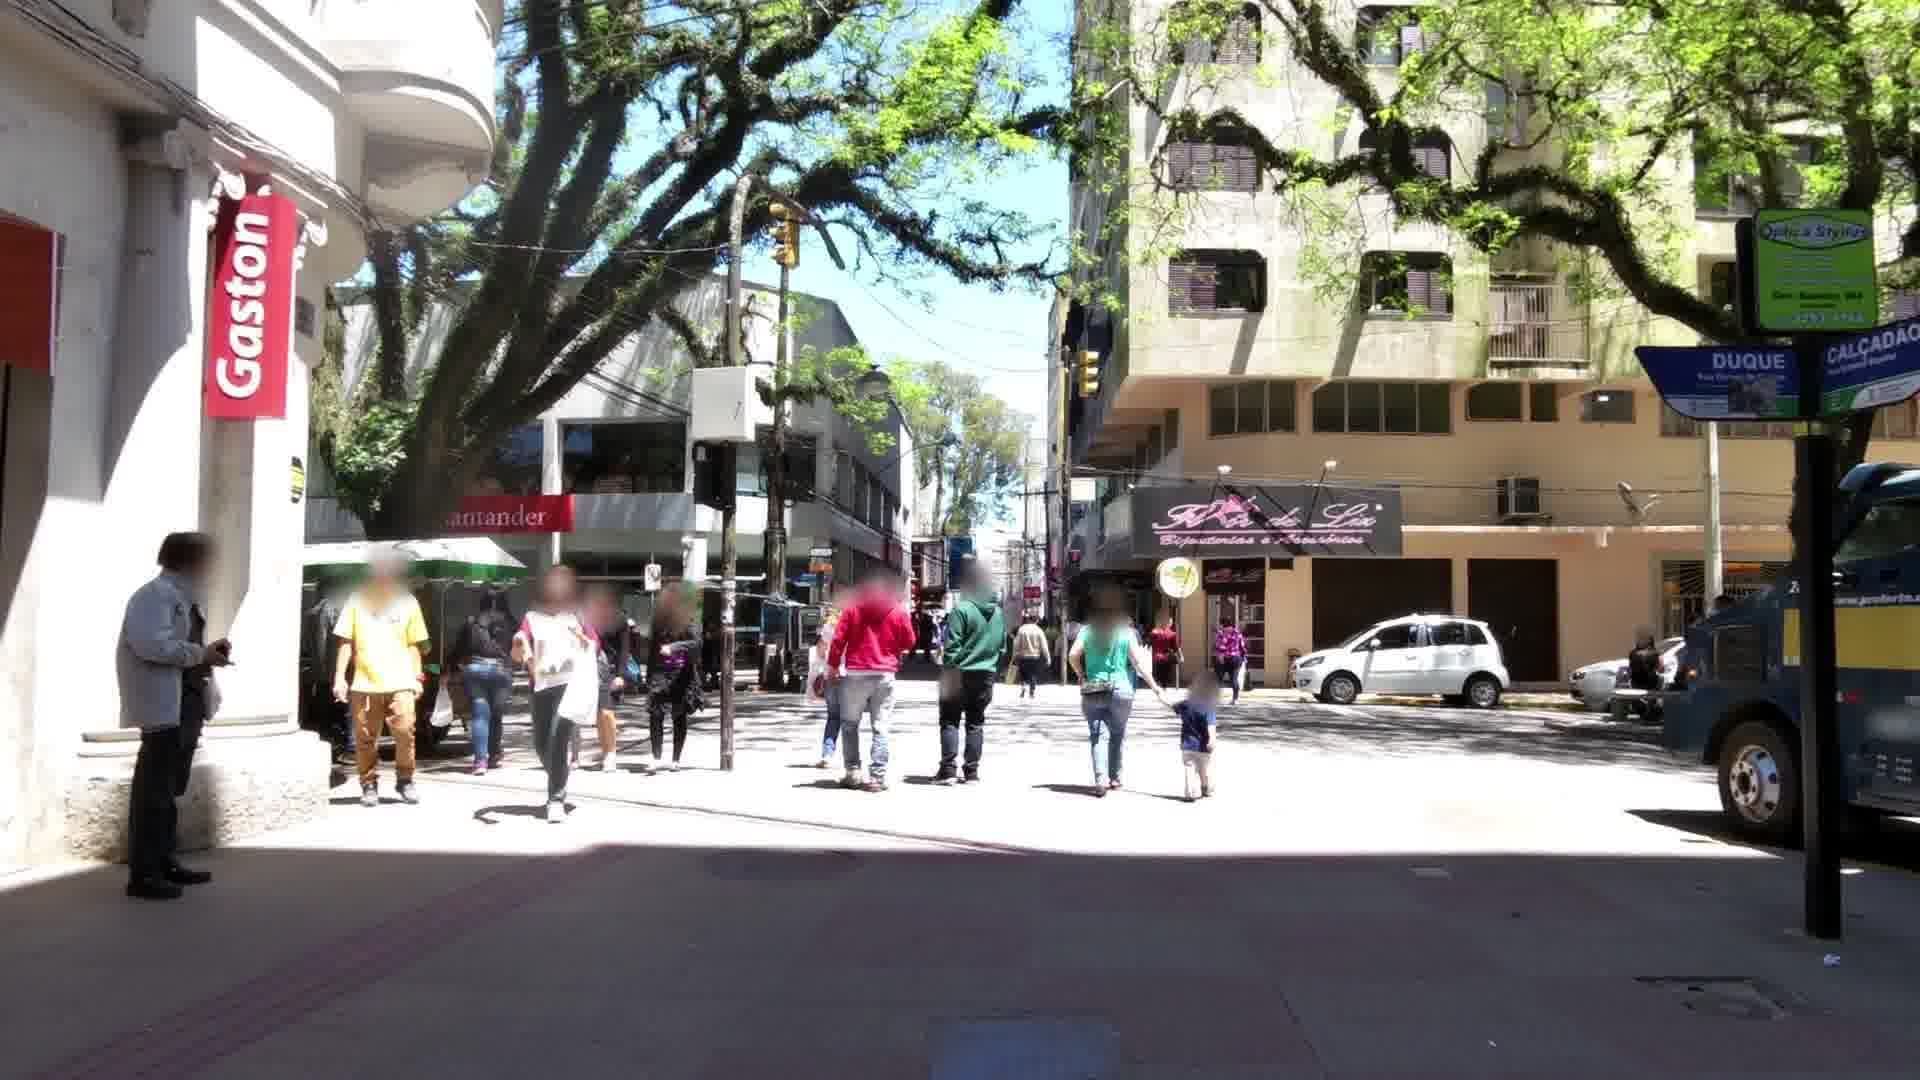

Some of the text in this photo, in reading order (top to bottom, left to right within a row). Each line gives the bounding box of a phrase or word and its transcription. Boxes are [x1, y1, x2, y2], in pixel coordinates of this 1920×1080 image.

[216, 212, 270, 399] Gaston
[1712, 352, 1785, 369] DUQUE
[443, 503, 548, 528] antander
